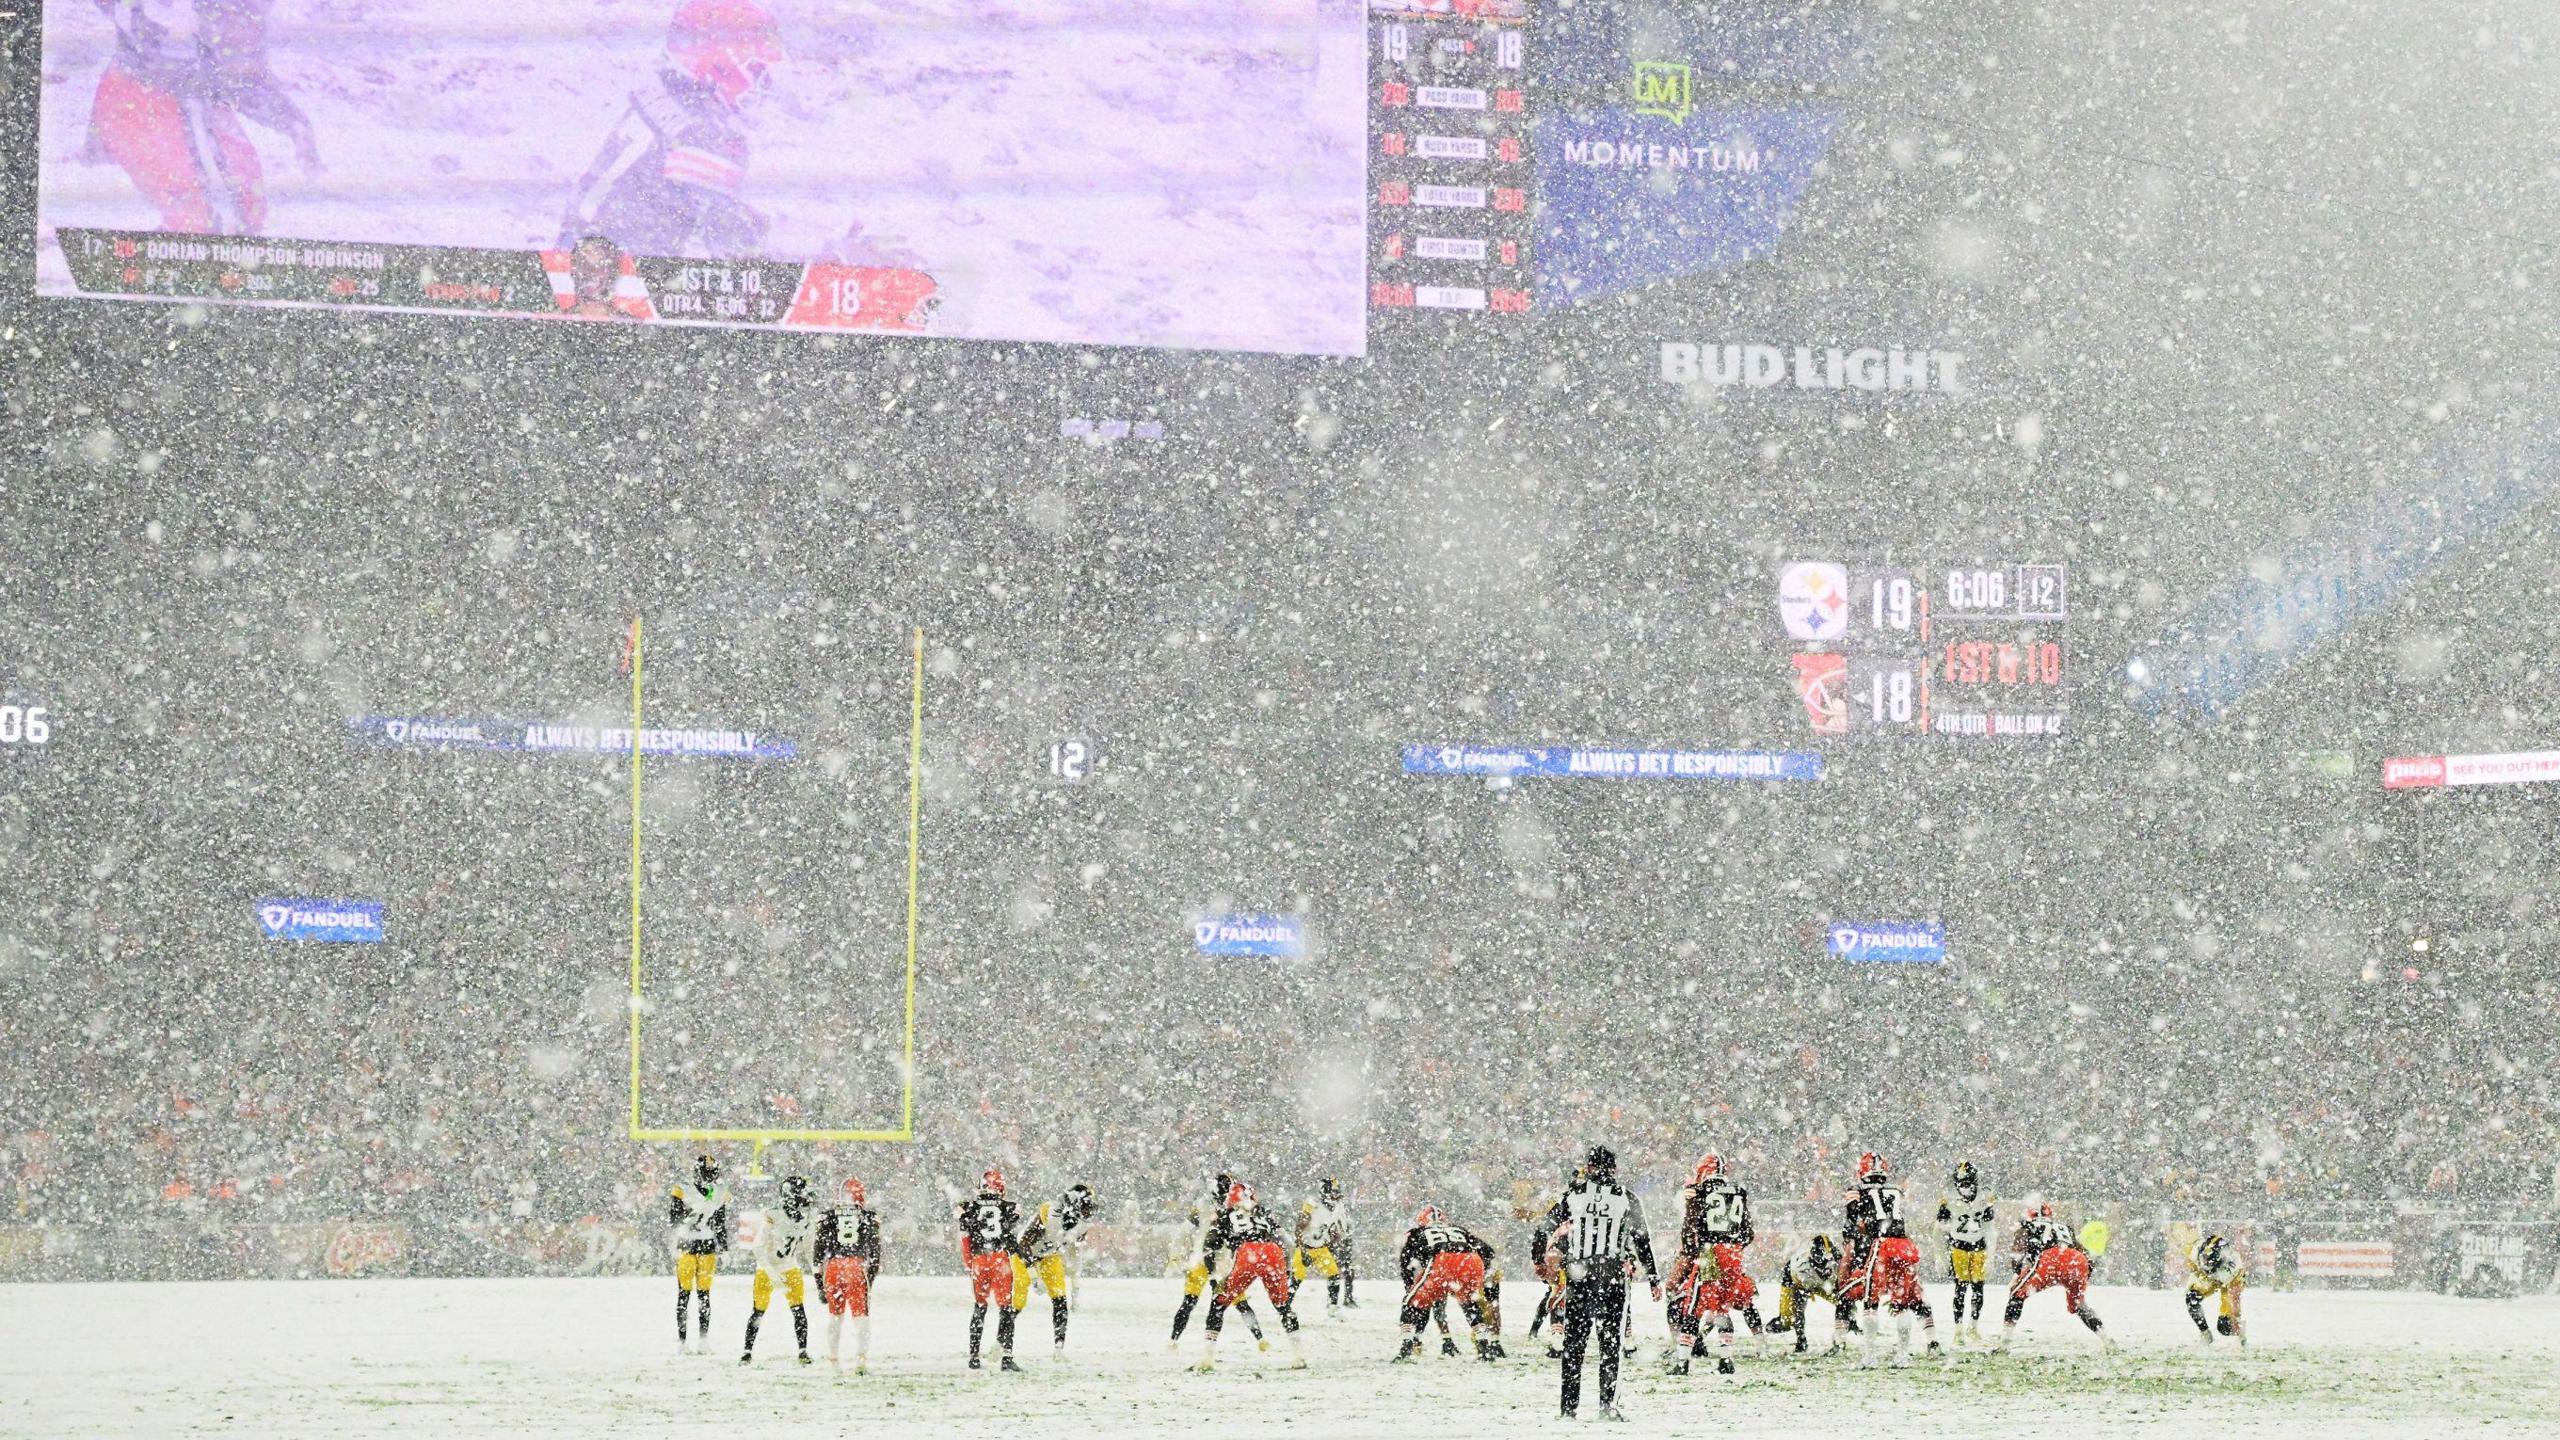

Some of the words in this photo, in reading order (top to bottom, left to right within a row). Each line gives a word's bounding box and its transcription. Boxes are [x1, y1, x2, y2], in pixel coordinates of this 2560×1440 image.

[1384, 24, 1408, 61] 19
[1497, 30, 1521, 68] 18
[1564, 140, 1759, 172] MOMENTUM
[147, 240, 206, 260] DORIAN
[680, 267, 711, 292] 1ST
[741, 270, 761, 294] 10
[829, 279, 860, 315] 18
[1660, 342, 1785, 386] BUD
[1795, 346, 1967, 391] LIGHT
[1873, 578, 1911, 629] 19
[1948, 571, 2004, 609] 6:06
[2031, 577, 2054, 606] 12
[1945, 643, 1993, 683] 1ST
[2026, 643, 2060, 685] 10
[1873, 671, 1911, 722] 18
[525, 725, 596, 748] ALWAYS
[601, 728, 635, 749] BET
[638, 729, 757, 752] RESPONSIBLY
[1936, 713, 1960, 733] 4TH
[1962, 713, 1987, 735] QTR
[2026, 714, 2043, 734] ON
[2044, 714, 2061, 735] 42
[1051, 742, 1085, 778] 12
[1464, 753, 1531, 768] FANDUEL
[1569, 752, 1635, 773] ALWAYS
[1639, 753, 1670, 774] BET
[1673, 753, 1784, 776] RESPONSIBLY
[2453, 765, 2474, 775] SEE
[2480, 763, 2502, 774] YOU
[2507, 762, 2530, 772] OUT
[291, 911, 376, 928] FANDUEL
[1220, 927, 1297, 941] FANDUEL
[1861, 933, 1938, 949] FANDUEL
[1586, 1202, 1610, 1218] 42
[1706, 1192, 1743, 1231] 24
[1868, 1187, 1902, 1220] 17
[978, 1205, 1002, 1240] 3
